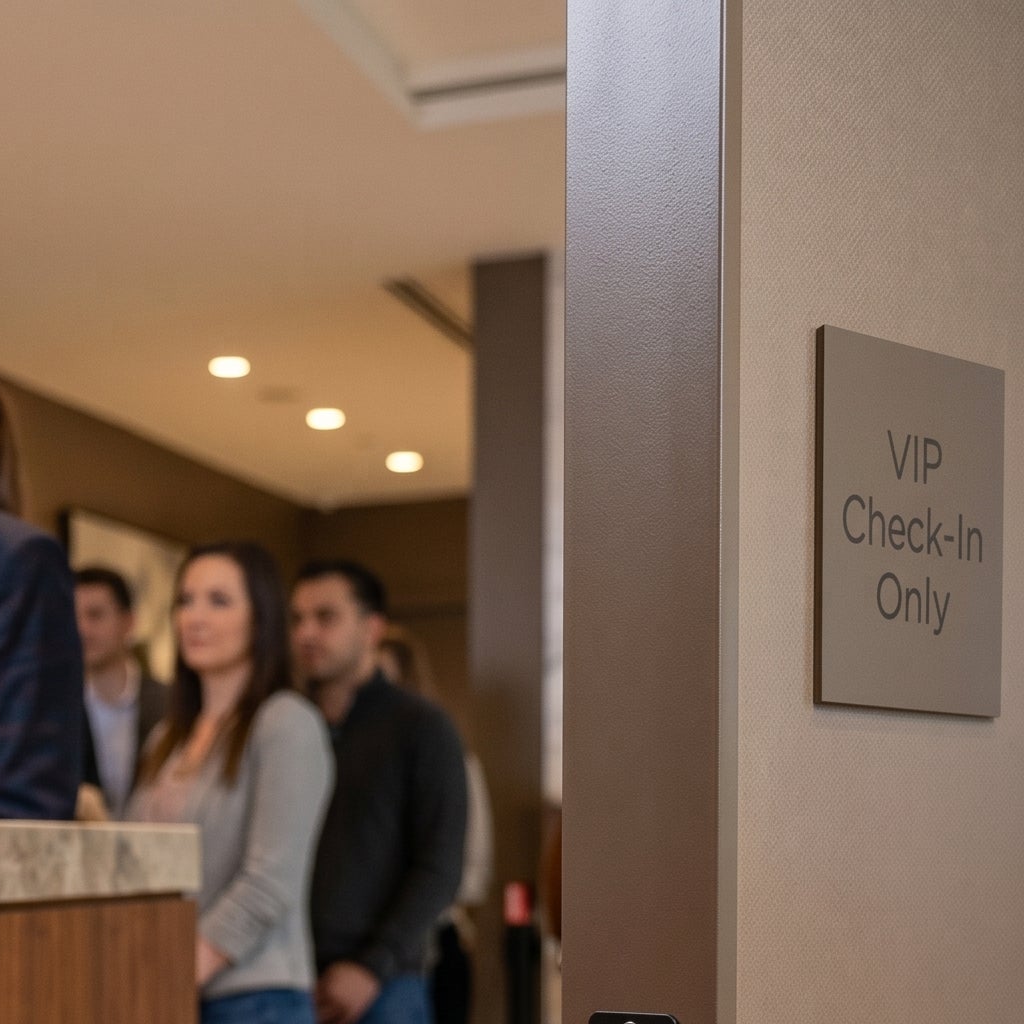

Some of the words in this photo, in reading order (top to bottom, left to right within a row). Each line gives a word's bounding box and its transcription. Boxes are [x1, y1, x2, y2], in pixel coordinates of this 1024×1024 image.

[887, 430, 942, 484] VIP
[843, 494, 983, 562] Check-In
[877, 572, 950, 635] Only
